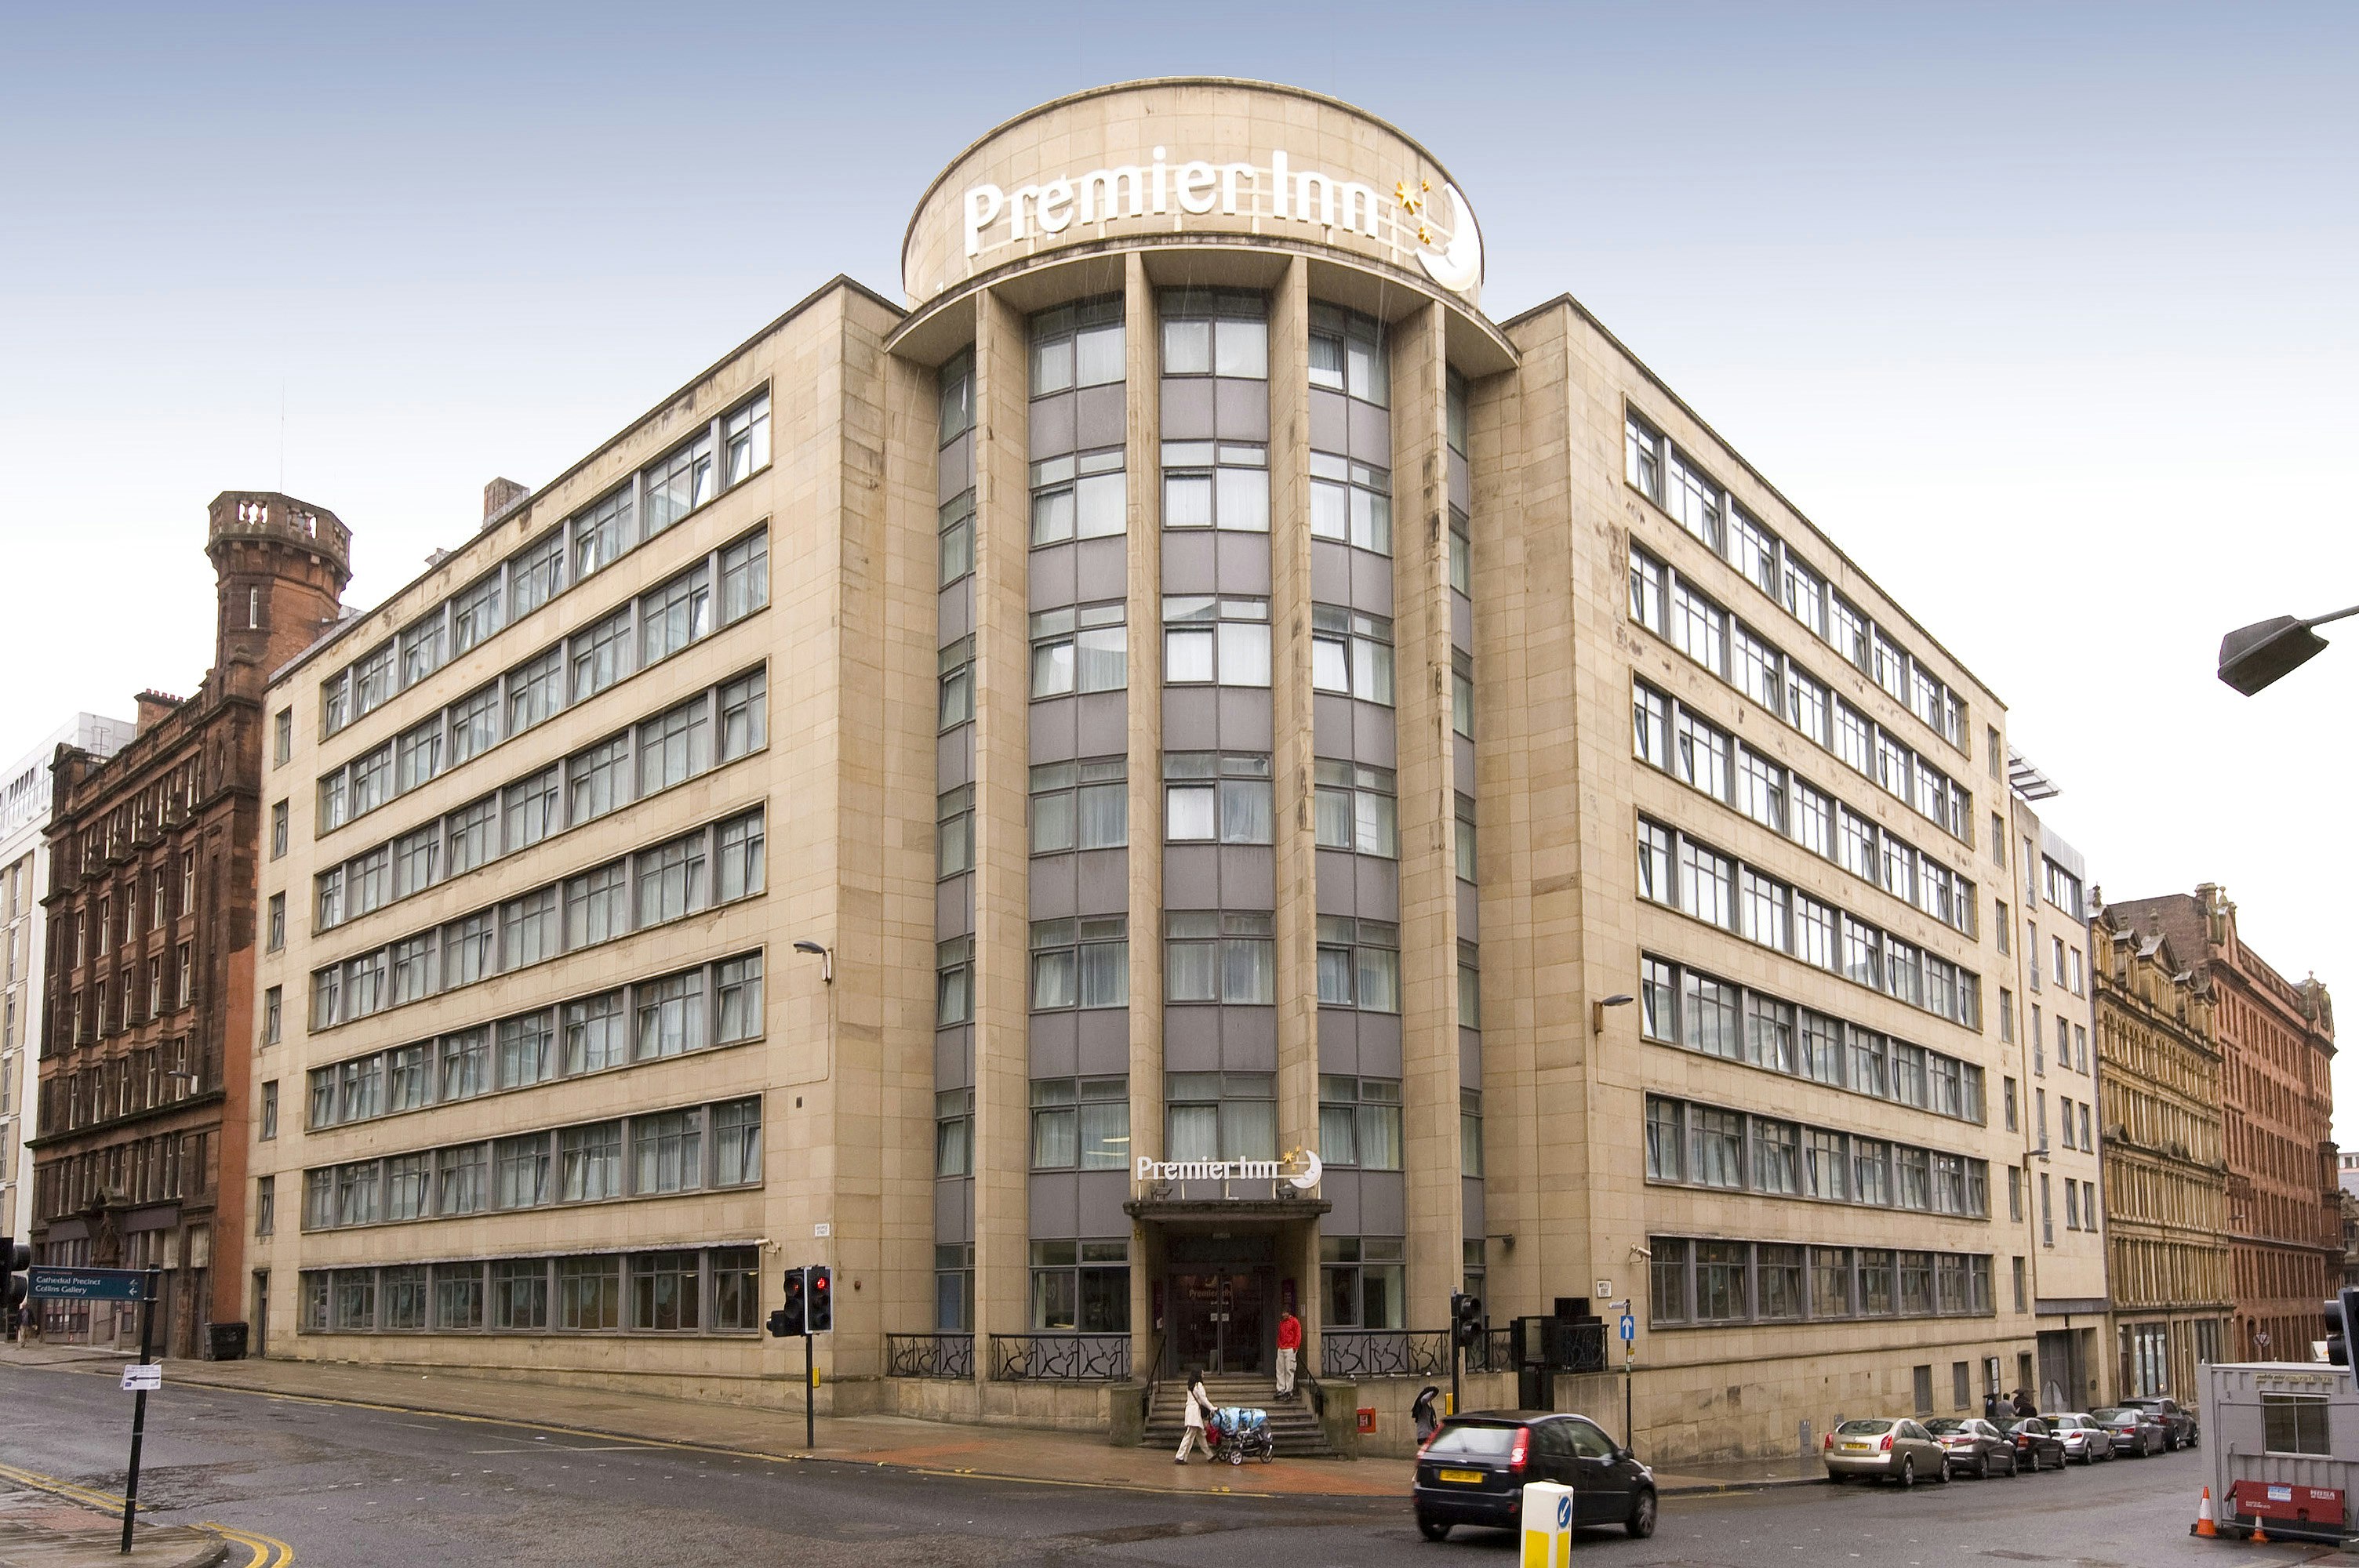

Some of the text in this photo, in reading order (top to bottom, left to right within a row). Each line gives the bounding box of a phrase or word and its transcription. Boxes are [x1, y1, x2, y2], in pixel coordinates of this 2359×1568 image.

[964, 145, 1379, 258] Premier Inn
[1137, 1155, 1278, 1181] Premier Inn
[36, 1276, 71, 1285] Cathedral
[61, 1286, 87, 1294] Gallery
